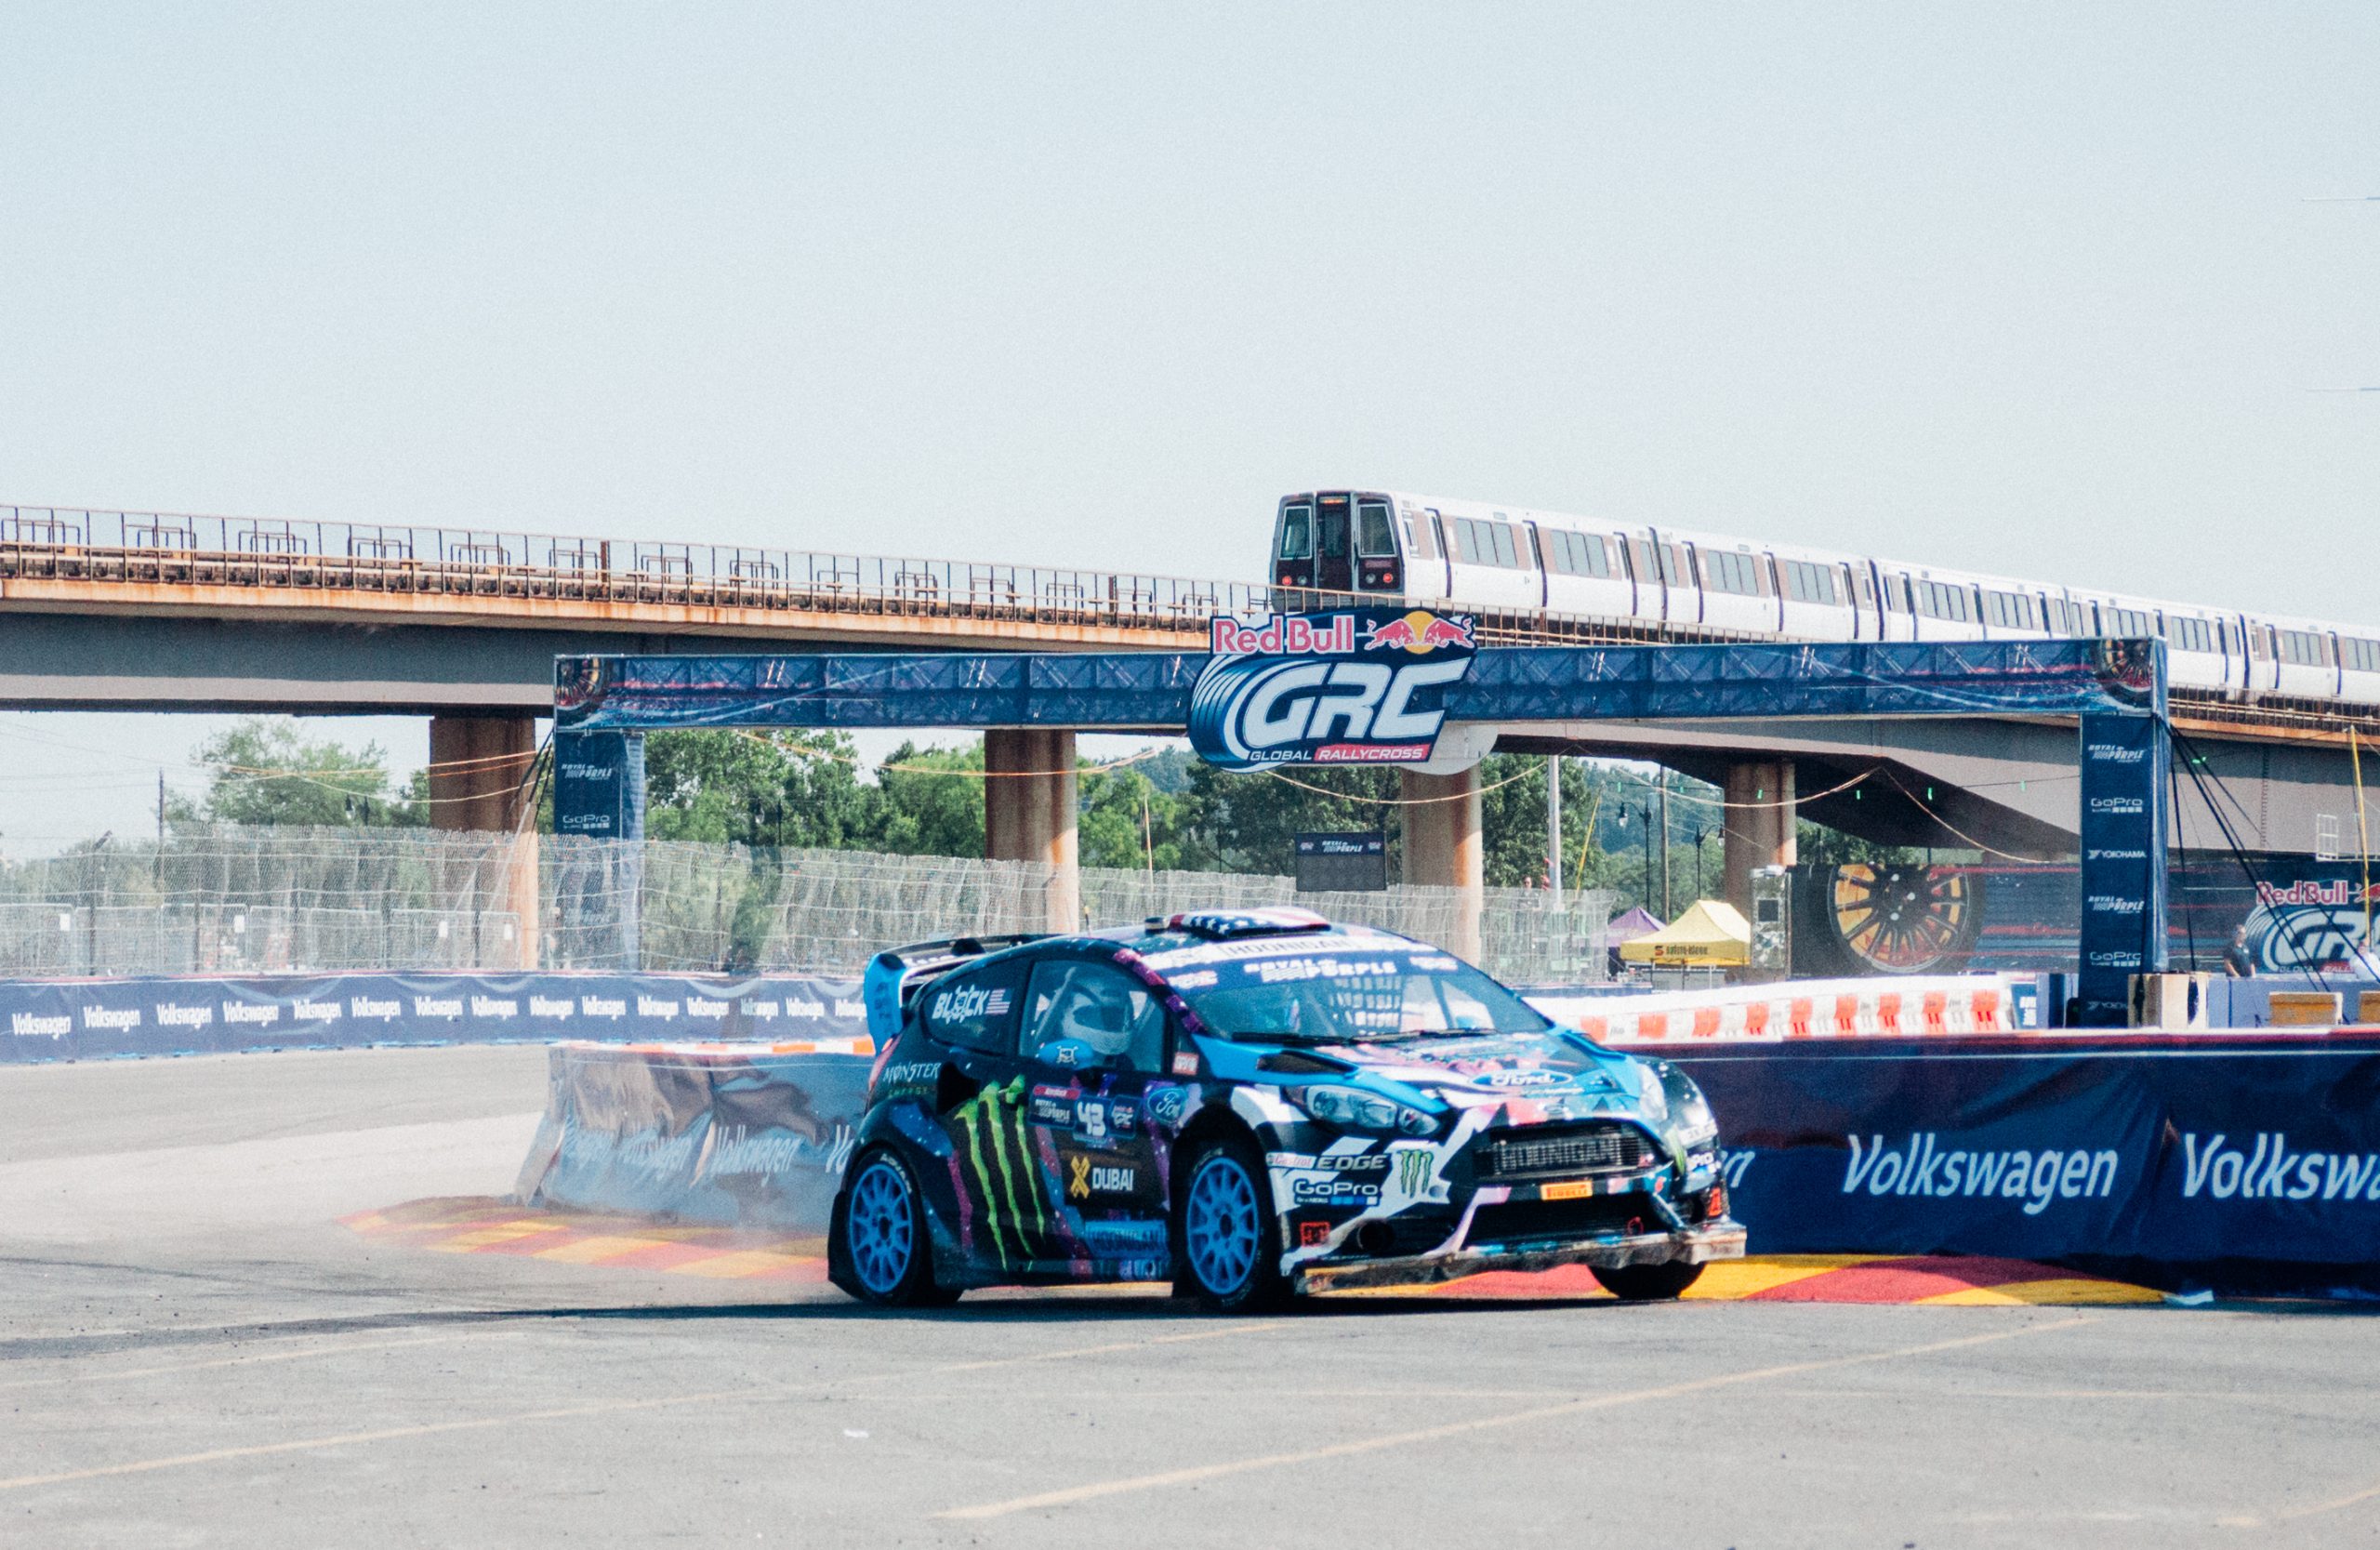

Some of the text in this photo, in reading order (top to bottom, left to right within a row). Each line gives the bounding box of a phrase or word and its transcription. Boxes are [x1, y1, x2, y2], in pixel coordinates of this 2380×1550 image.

[1213, 615, 1355, 653] Red Bull
[1243, 656, 1471, 748] GRC
[1250, 748, 1423, 762] GLOBAL RALLYCROSS
[2090, 797, 2143, 807] GoPro
[562, 815, 610, 824] GoPro
[2256, 880, 2348, 907] Red Bull
[2274, 910, 2380, 965] GR
[84, 1005, 140, 1032] Volkswagen
[156, 1002, 212, 1029] Volkswagen
[223, 1000, 278, 1027] Volkswagen
[293, 999, 342, 1024] Volkswagen
[351, 997, 401, 1022] Volkswagen
[415, 996, 463, 1021] Volkswagen
[12, 1013, 71, 1040] Volkswagen
[883, 1061, 942, 1083] MONSTER
[1491, 1070, 1556, 1087] Ford
[1077, 1101, 1106, 1136] 43
[709, 1124, 805, 1187] Volkswagen
[1316, 1154, 1387, 1171] EDGE
[1092, 1167, 1133, 1190] DUBAI
[1842, 1133, 2118, 1215] Volkswagen
[1295, 1180, 1379, 1195] GoPro
